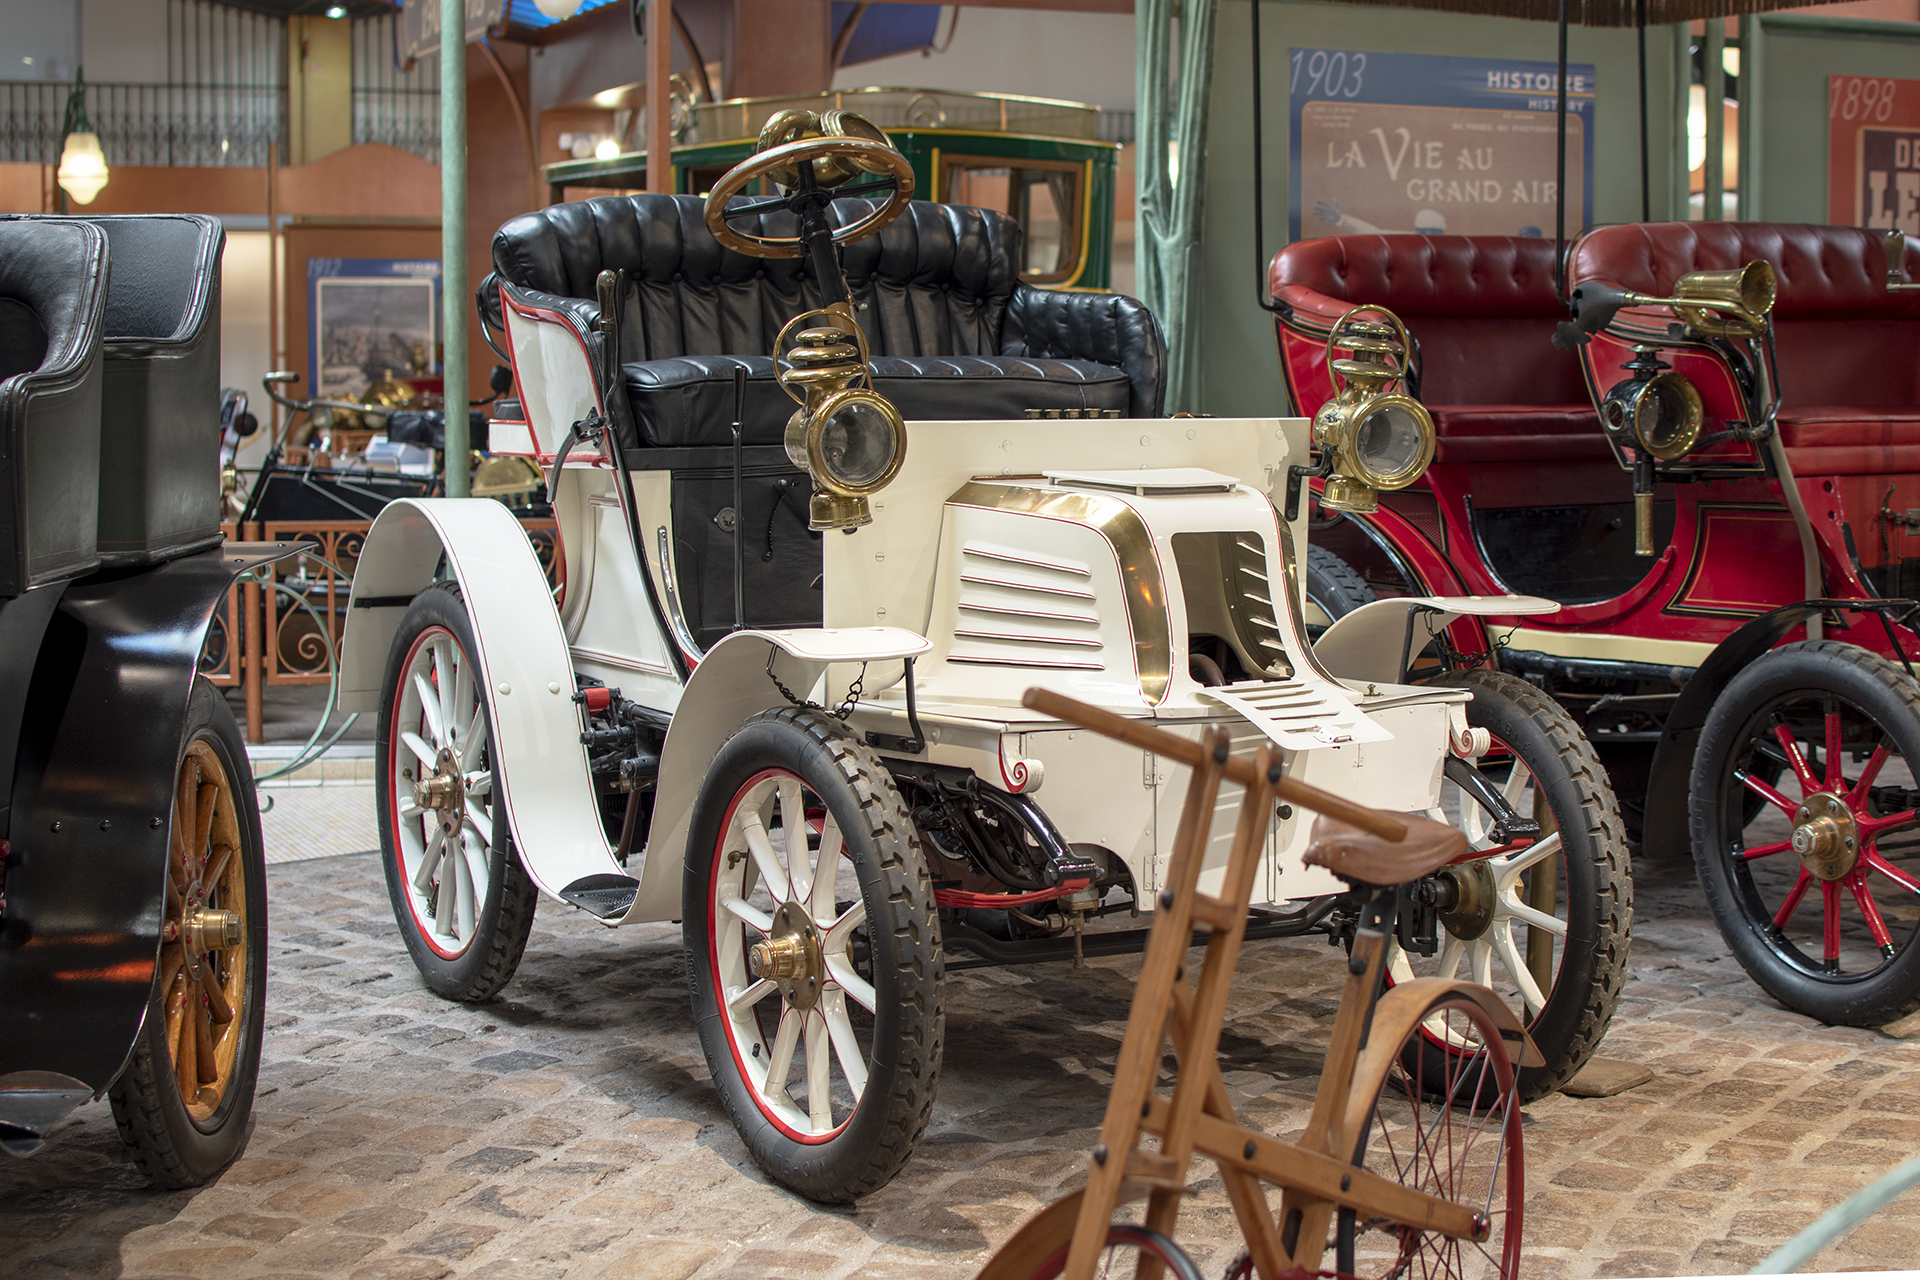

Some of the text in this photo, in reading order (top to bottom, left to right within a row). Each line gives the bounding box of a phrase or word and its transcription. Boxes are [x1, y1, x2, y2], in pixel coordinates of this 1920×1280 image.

[1290, 50, 1367, 97] 1903
[1528, 98, 1585, 112] HISTRY
[1829, 78, 1896, 122] 1898
[1326, 127, 1494, 181] LA VIE AU
[1406, 179, 1559, 203] GRAND AIR
